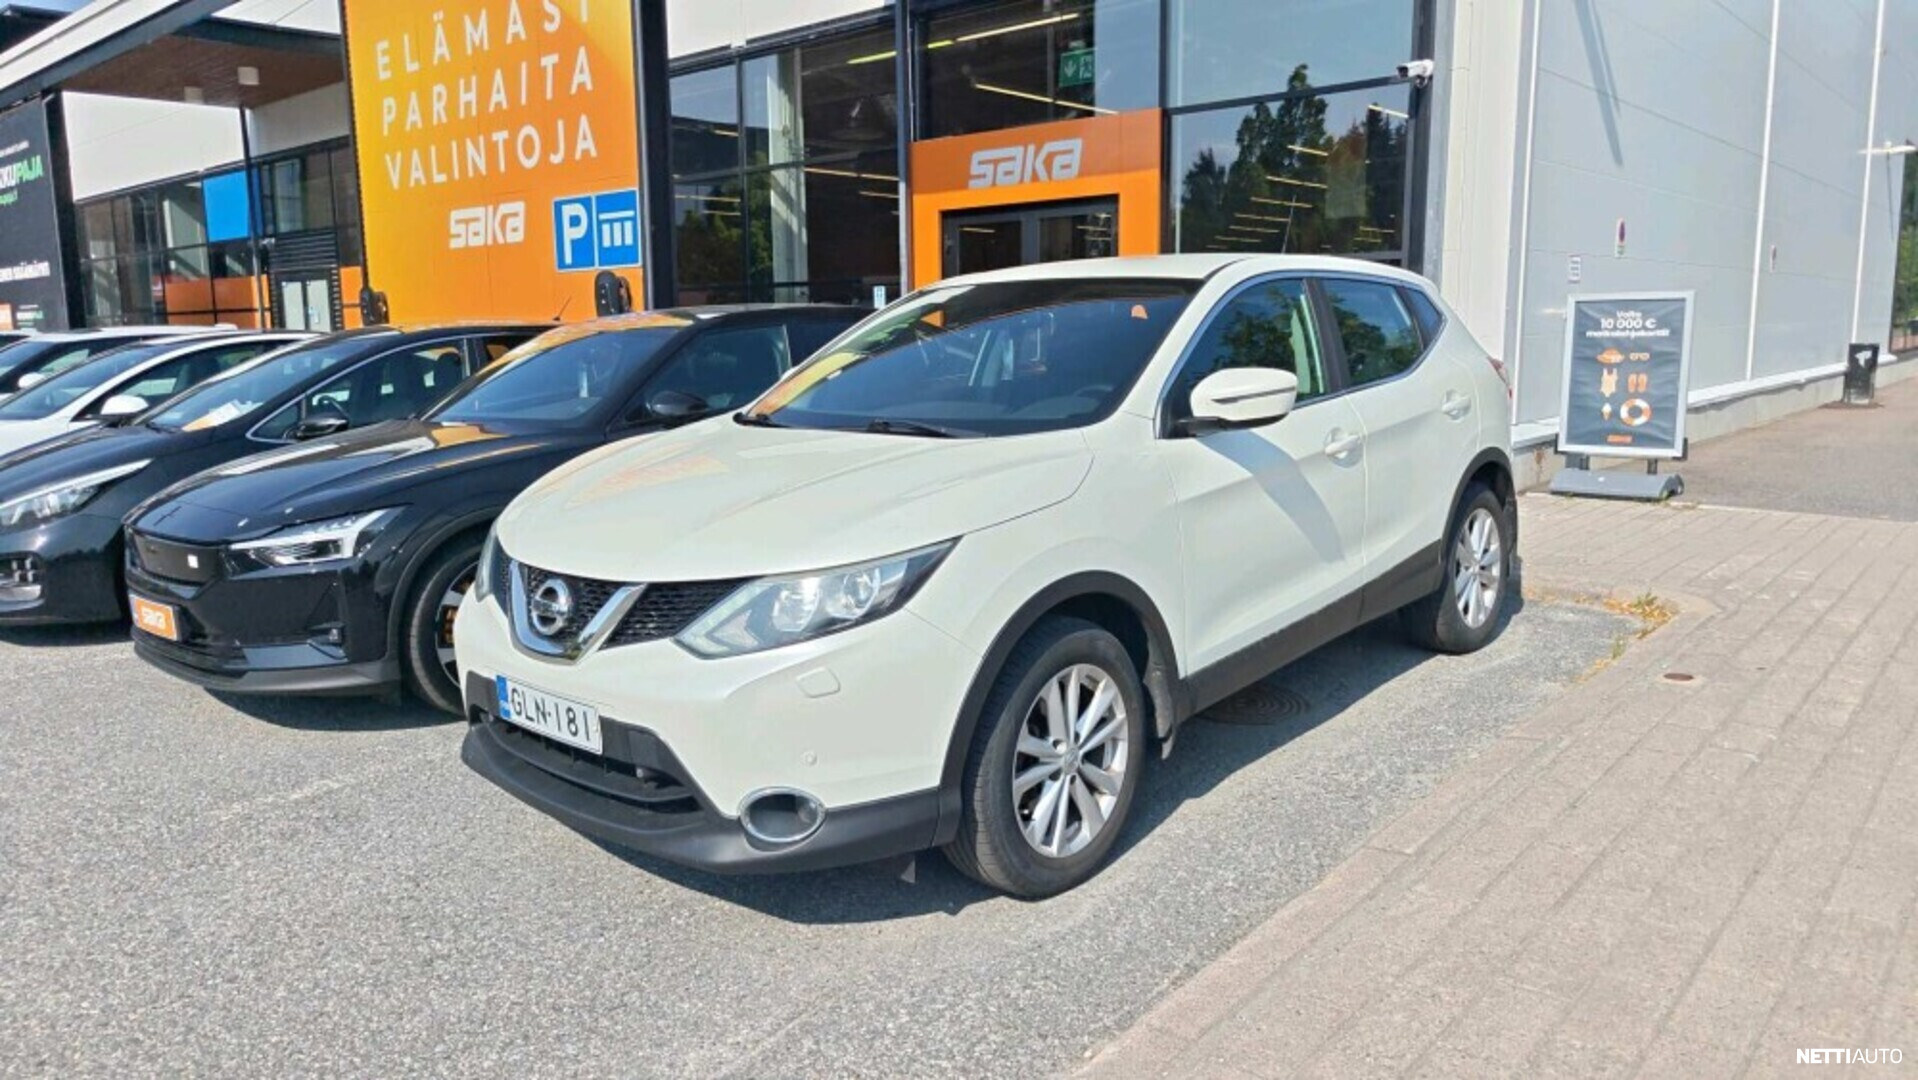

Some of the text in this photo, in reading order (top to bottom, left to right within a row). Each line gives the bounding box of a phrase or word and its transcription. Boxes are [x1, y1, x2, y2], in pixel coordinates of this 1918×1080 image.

[383, 45, 593, 136] PARHAITA
[385, 114, 597, 190] VALINTOJA
[561, 203, 588, 265] P
[1601, 318, 1614, 329] 10
[1616, 318, 1643, 329] 000
[511, 687, 590, 742] GLN-181
